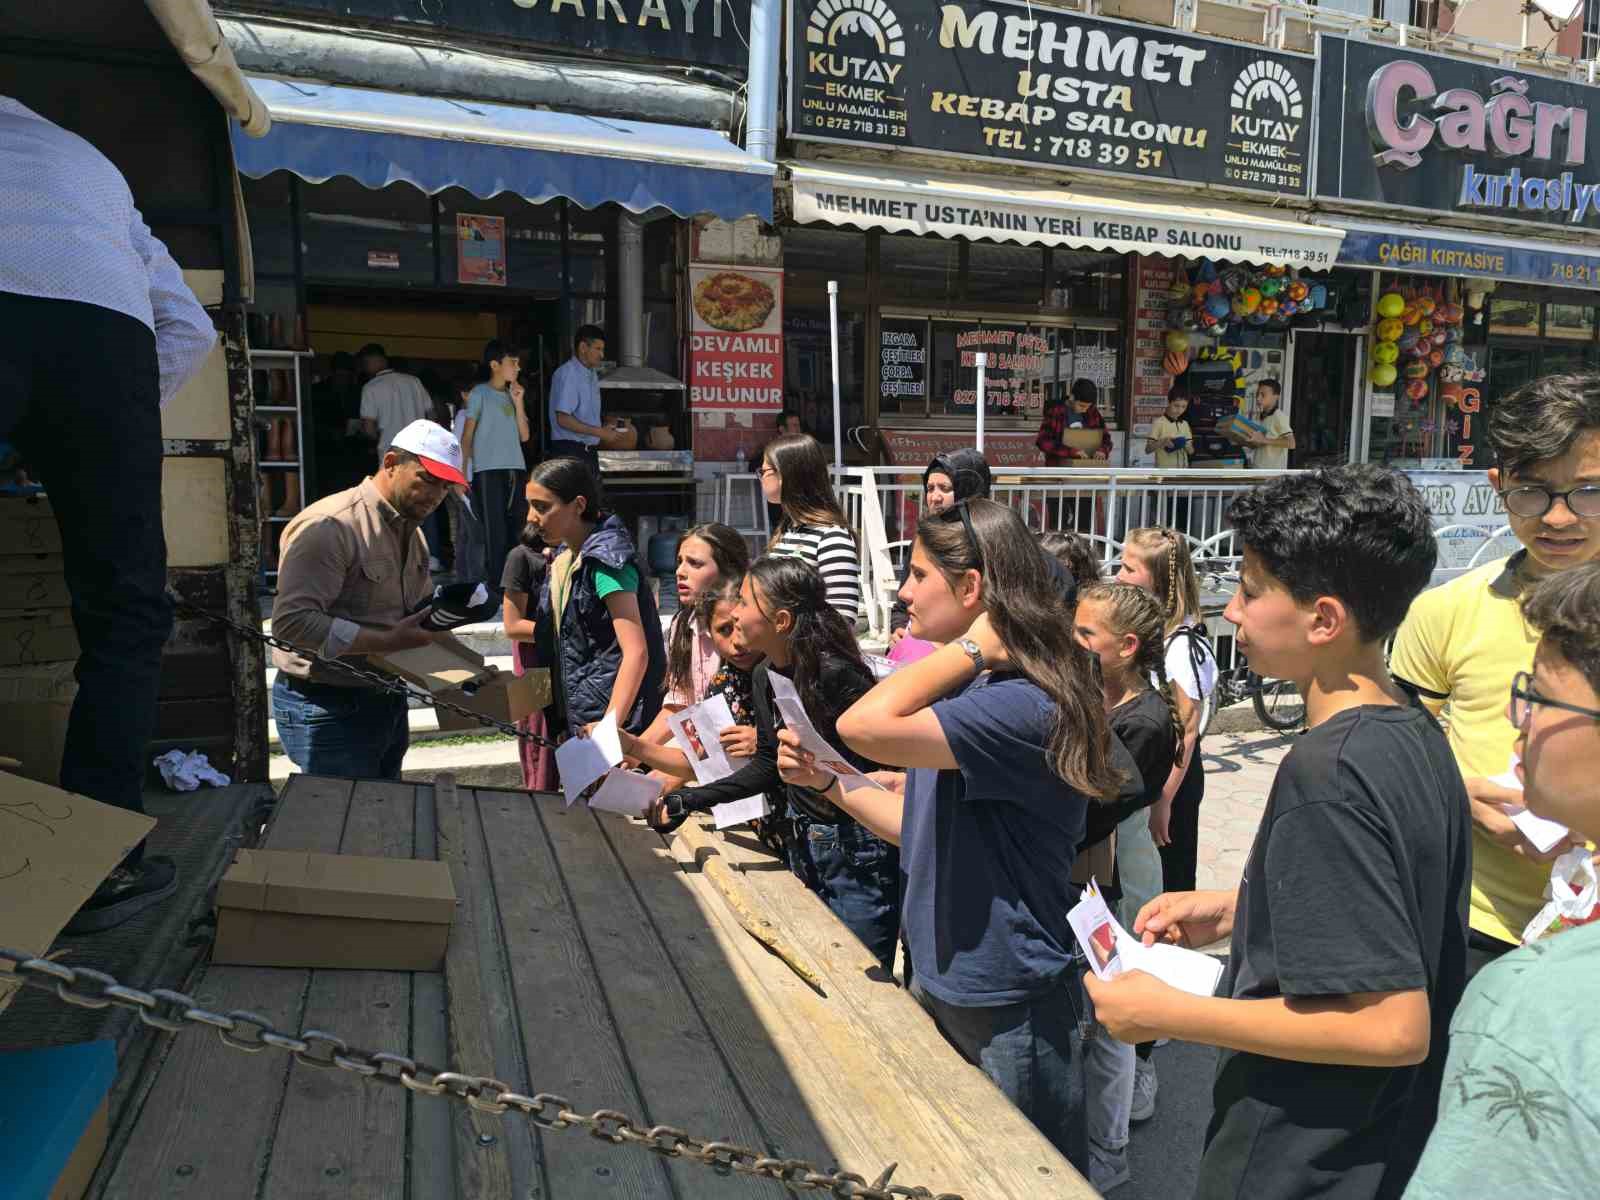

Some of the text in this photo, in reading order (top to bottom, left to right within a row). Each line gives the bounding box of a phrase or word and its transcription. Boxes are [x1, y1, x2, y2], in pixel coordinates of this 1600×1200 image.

[513, 0, 722, 38] RAYI
[938, 5, 1207, 87] MEHMET
[809, 51, 903, 85] KUTAY
[825, 82, 886, 103] EKMEK
[1017, 71, 1134, 112] USTA
[815, 115, 906, 137] 0 272 718 31 33
[930, 92, 1207, 148] KEBAP SALONU
[1231, 114, 1299, 142] KUTAY
[983, 127, 1027, 150] TEL
[1049, 136, 1093, 158] 718
[1097, 143, 1129, 165] 39
[1135, 149, 1162, 169] 51
[1242, 140, 1287, 158] EKMEK
[1242, 170, 1260, 182] 272
[1261, 173, 1276, 184] 718
[1278, 175, 1287, 185] 31
[815, 193, 1242, 251] MEHMET USTA'NIN YERİ KEBAP SALONU
[1302, 248, 1316, 263] 39
[1317, 251, 1329, 264] 51
[1379, 241, 1504, 272] ÇAĞRI KIRTASİYE
[690, 335, 780, 354] DEVAMLI
[696, 360, 774, 383] KEŞKEK
[690, 386, 783, 403] BULUNUR
